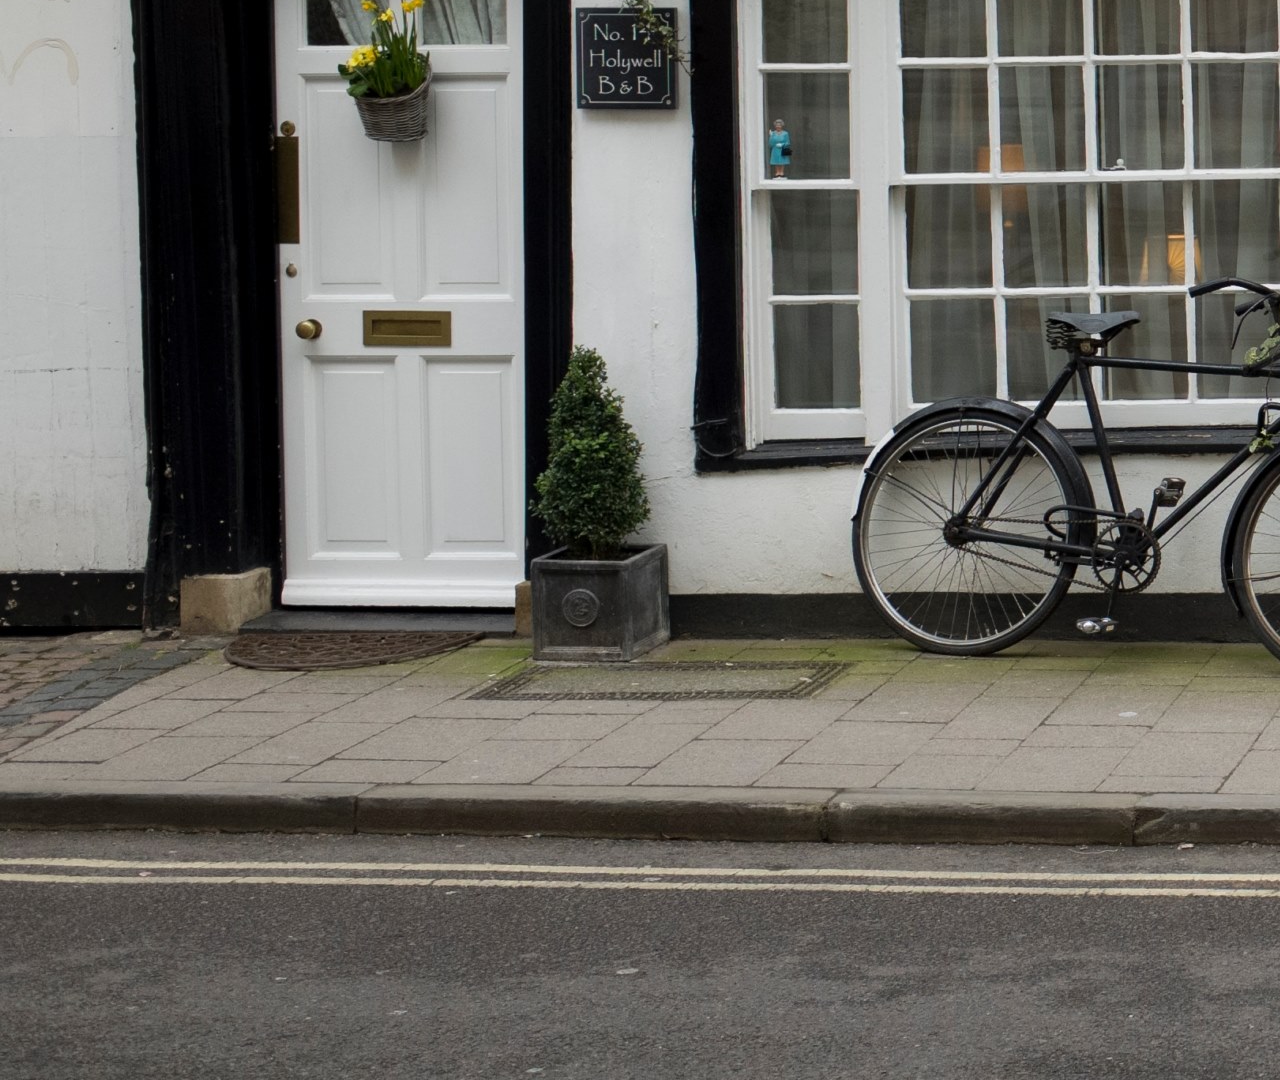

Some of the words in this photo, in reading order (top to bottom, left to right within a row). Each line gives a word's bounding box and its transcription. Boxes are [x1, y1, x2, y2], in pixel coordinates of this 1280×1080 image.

[593, 23, 625, 41] No.
[589, 49, 662, 75] Holywell
[598, 75, 615, 95] B
[619, 80, 633, 95] &
[637, 75, 654, 95] B
